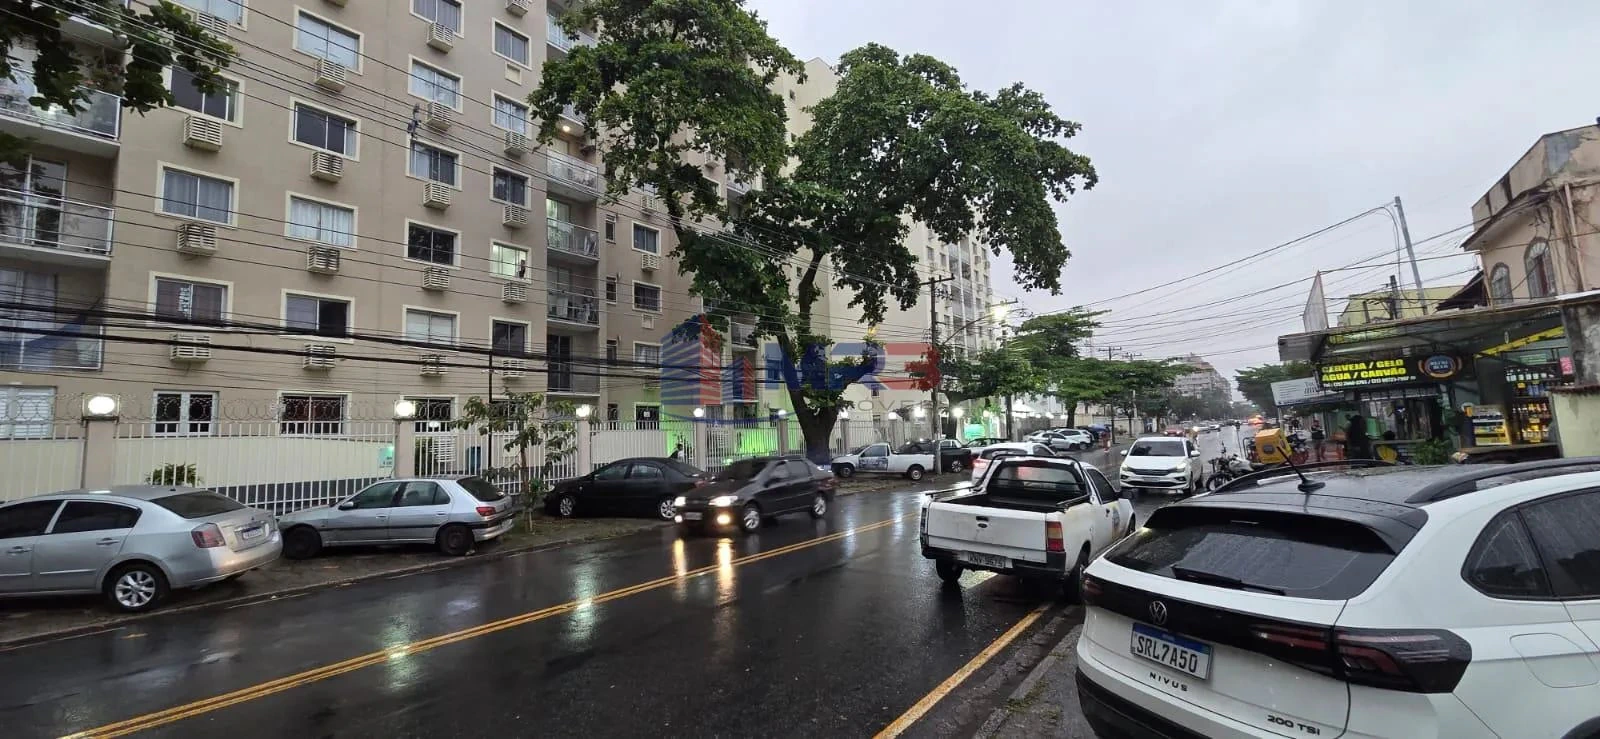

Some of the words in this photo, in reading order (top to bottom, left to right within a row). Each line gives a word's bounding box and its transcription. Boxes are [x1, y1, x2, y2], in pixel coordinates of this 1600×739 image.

[1322, 363, 1366, 372] CERVEJA
[1376, 359, 1403, 367] GELO
[1360, 368, 1406, 377] CARVÃO
[1136, 635, 1198, 673] SRL7A50
[1149, 672, 1188, 692] NIVUS
[1267, 714, 1294, 728] 200
[1297, 722, 1321, 736] TSI
